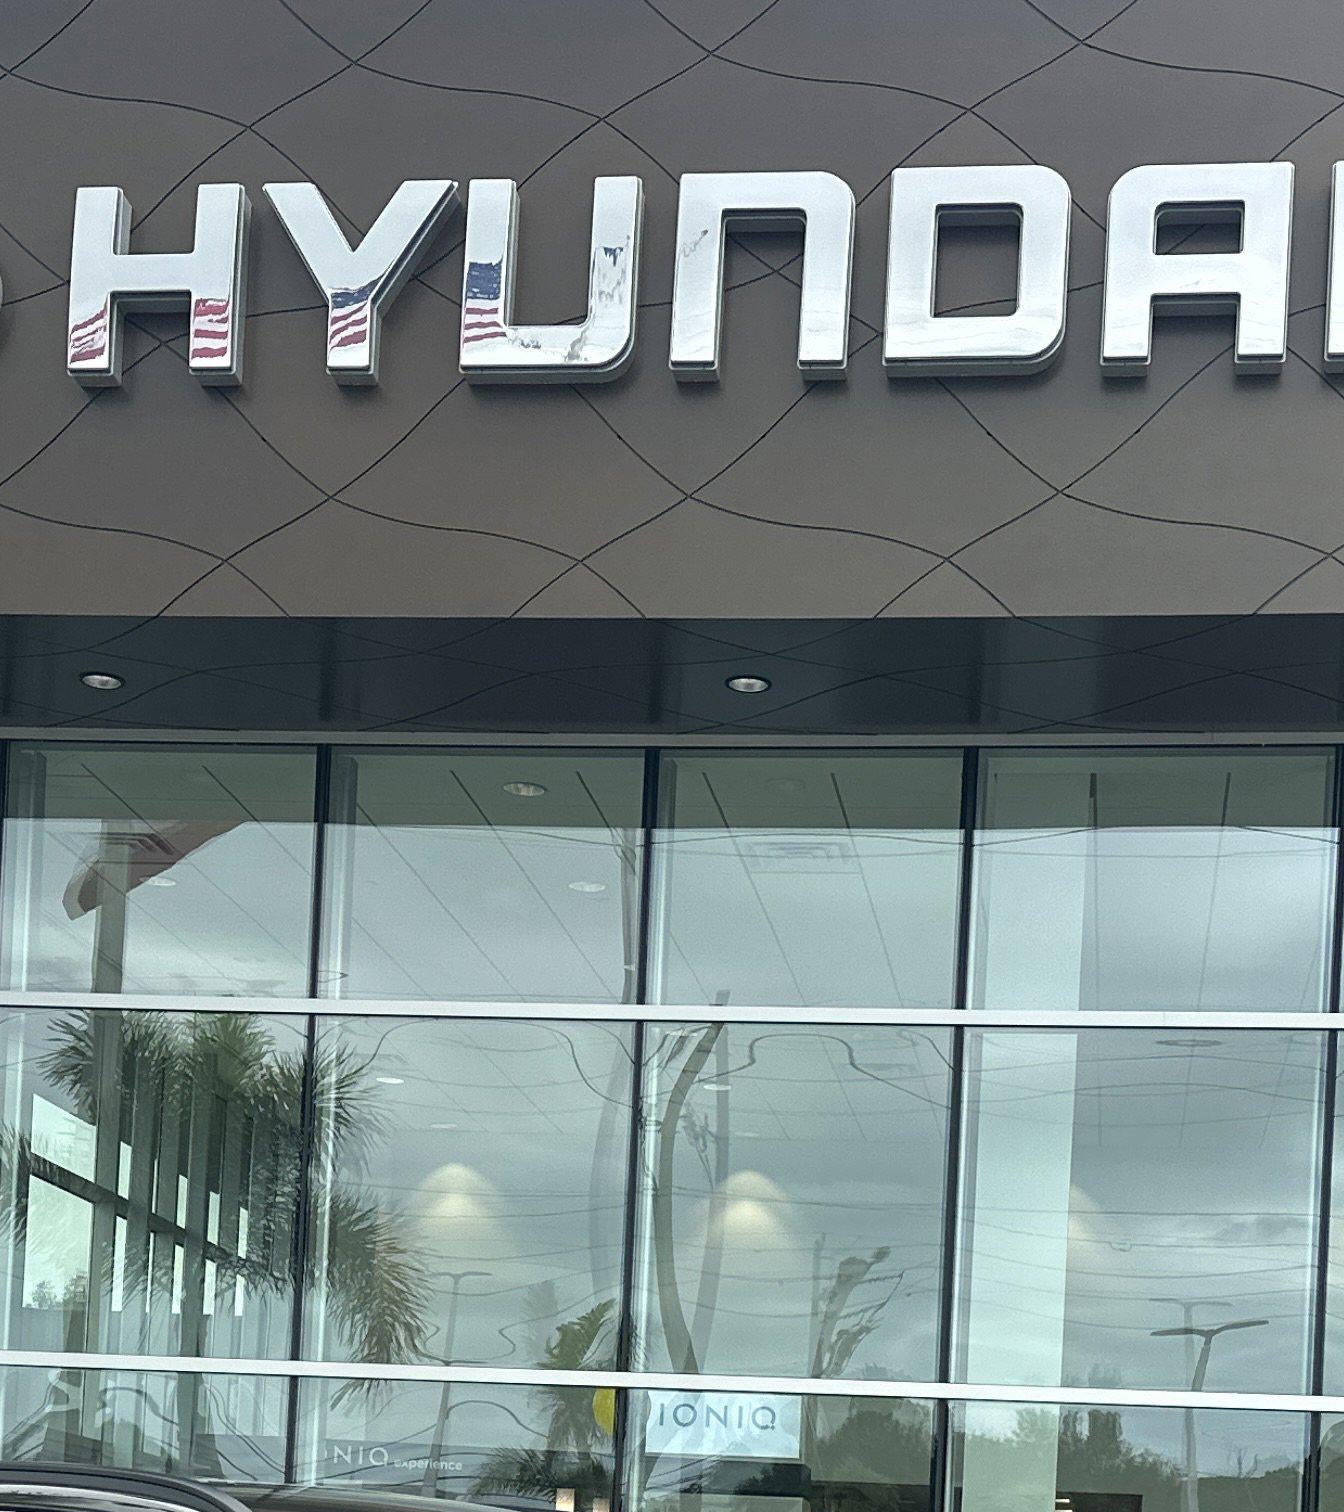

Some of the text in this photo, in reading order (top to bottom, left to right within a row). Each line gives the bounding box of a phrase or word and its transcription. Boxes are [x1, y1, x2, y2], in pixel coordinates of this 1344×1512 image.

[659, 1403, 776, 1430] IONIQ
[324, 1445, 463, 1471] NIQ experience
